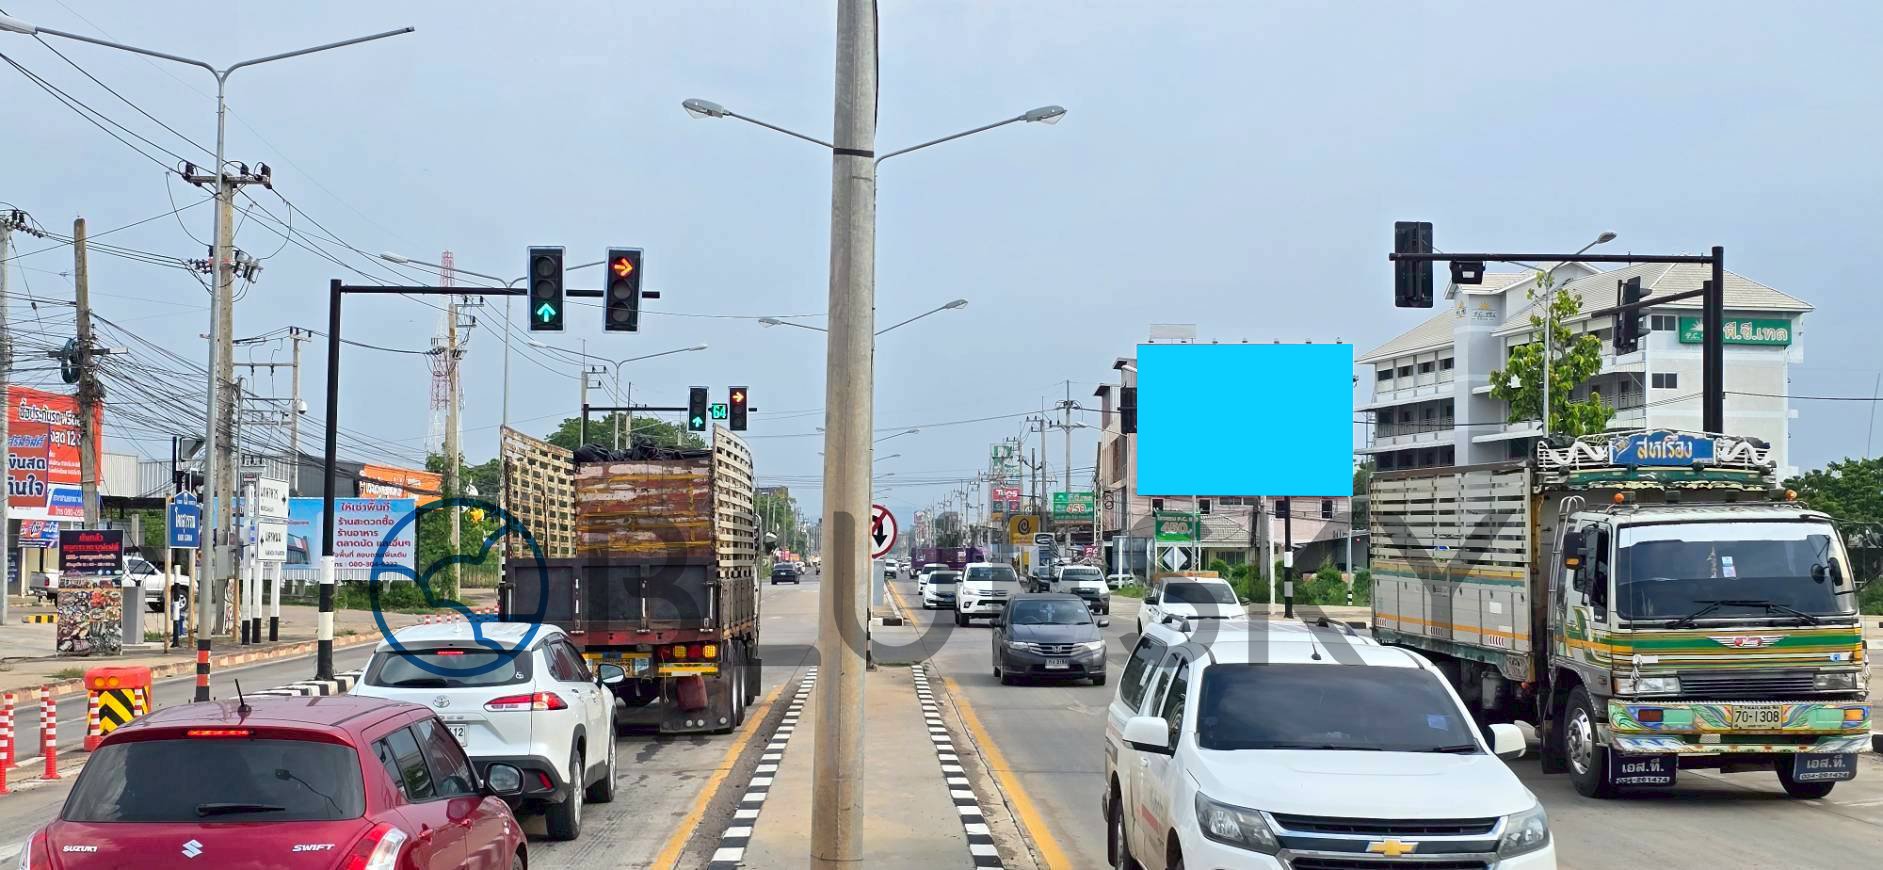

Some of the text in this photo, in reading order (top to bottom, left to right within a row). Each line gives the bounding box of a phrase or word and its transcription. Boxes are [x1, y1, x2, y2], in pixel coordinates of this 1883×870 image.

[713, 405, 726, 419] 64
[339, 515, 394, 526] ร้านสะดวกซื้อ
[338, 528, 379, 537] ร้านอาหาร
[336, 539, 373, 548] ตลาดนัด
[1736, 711, 1780, 722] 70-1308
[292, 844, 335, 852] SWIFT
